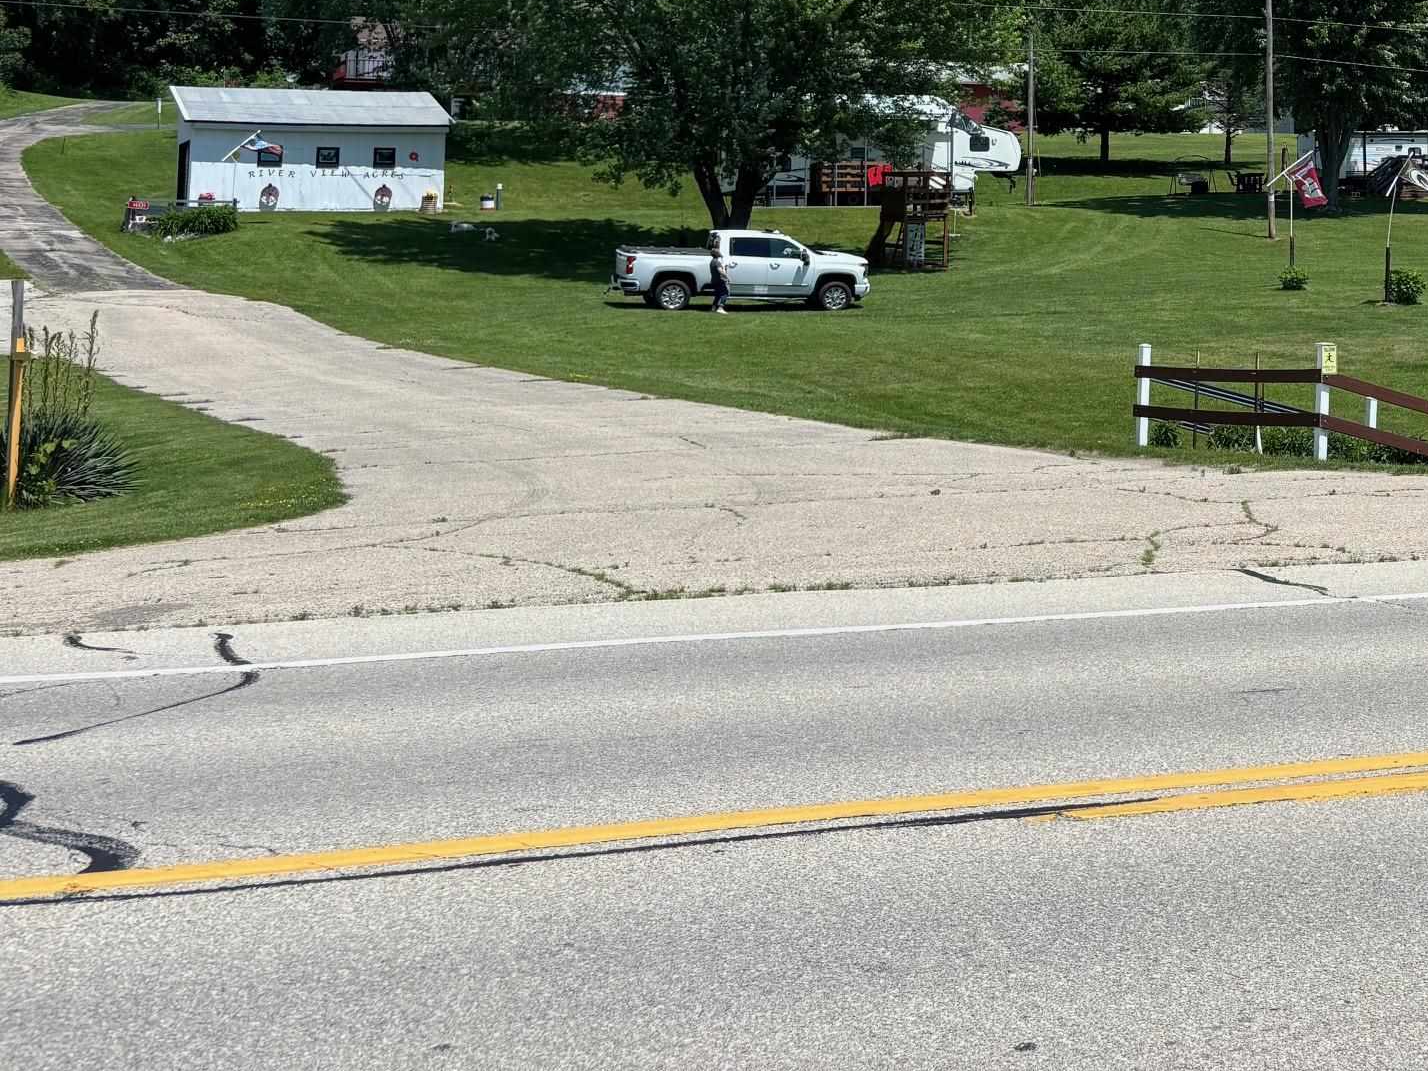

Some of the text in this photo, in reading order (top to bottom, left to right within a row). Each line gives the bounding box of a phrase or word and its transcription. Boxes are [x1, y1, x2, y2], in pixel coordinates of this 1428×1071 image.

[248, 169, 405, 180] RIVER VIEW ACRES
